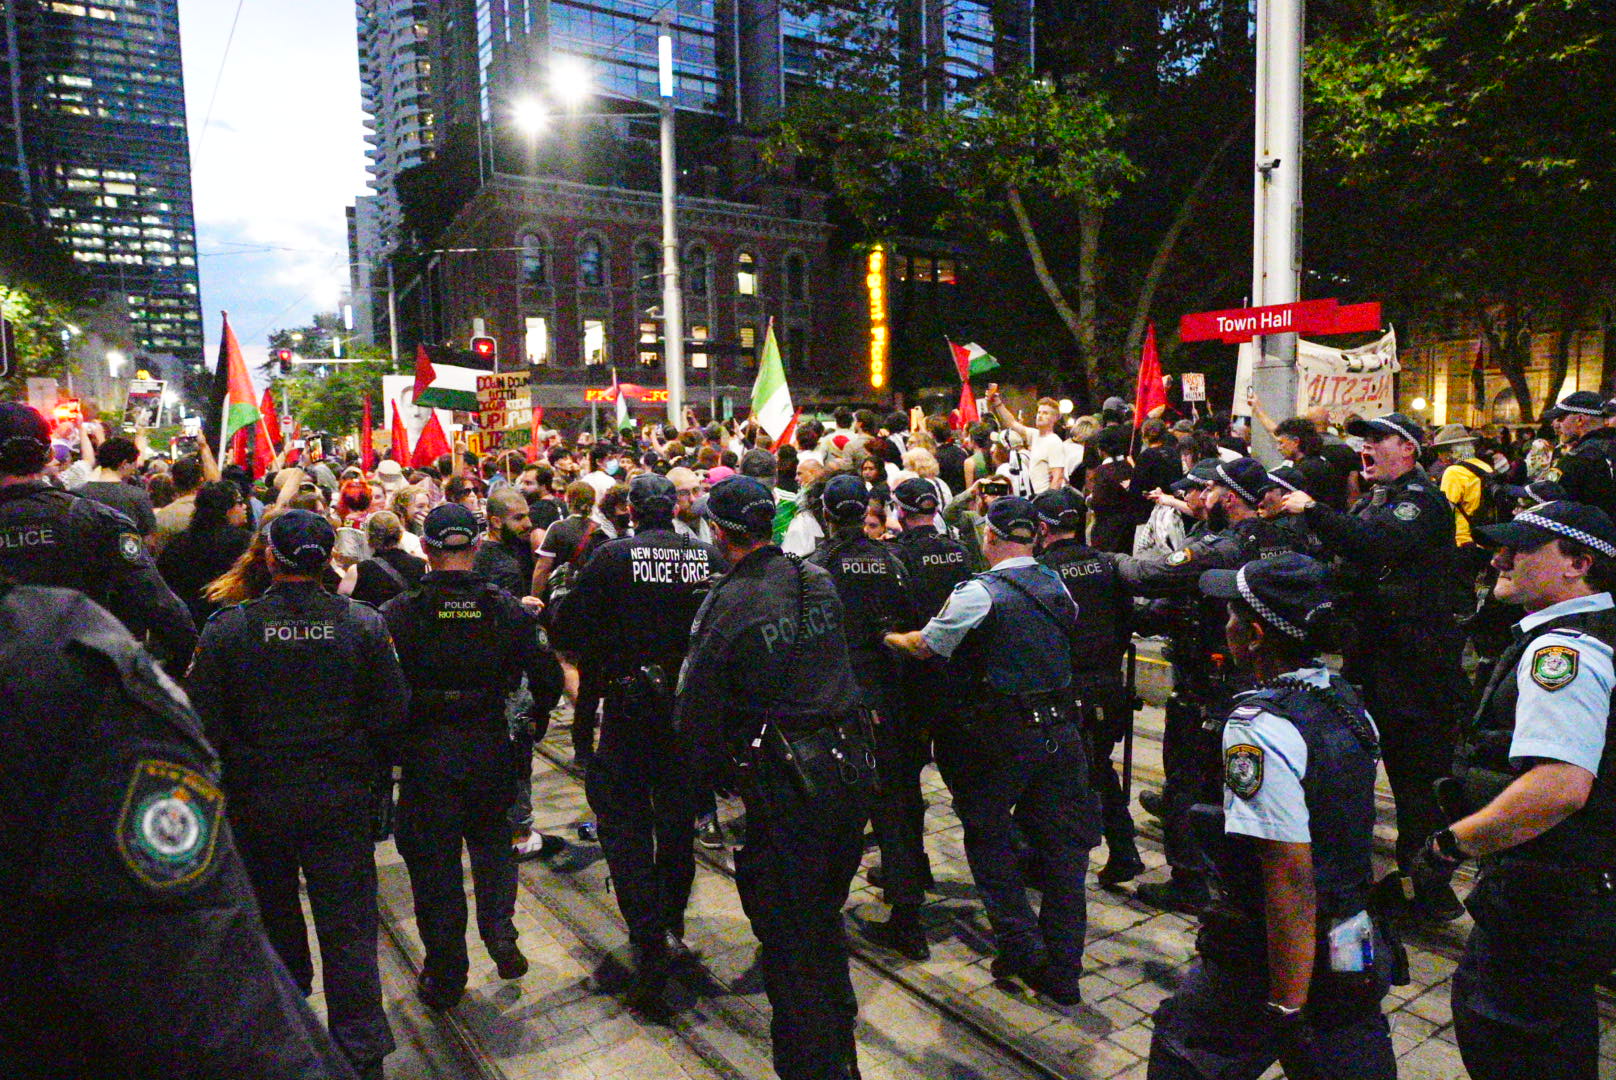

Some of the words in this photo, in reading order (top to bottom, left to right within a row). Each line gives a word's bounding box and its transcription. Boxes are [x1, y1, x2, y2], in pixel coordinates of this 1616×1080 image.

[1217, 316, 1257, 332] Town
[1260, 309, 1292, 329] Hall
[871, 326, 885, 388] Place
[477, 376, 505, 391] DOWN
[488, 388, 517, 400] WITH
[0, 529, 55, 548] LICE
[631, 547, 651, 560] NEW
[652, 548, 680, 561] SOUTH
[922, 552, 964, 566] POLICE
[632, 561, 673, 583] POLICE
[842, 562, 887, 574] POLICE
[1061, 562, 1103, 579] POLICE
[444, 601, 477, 609] POLICE
[438, 610, 455, 618] RIOT
[456, 610, 482, 619] SQUAD
[264, 626, 335, 642] POLICE
